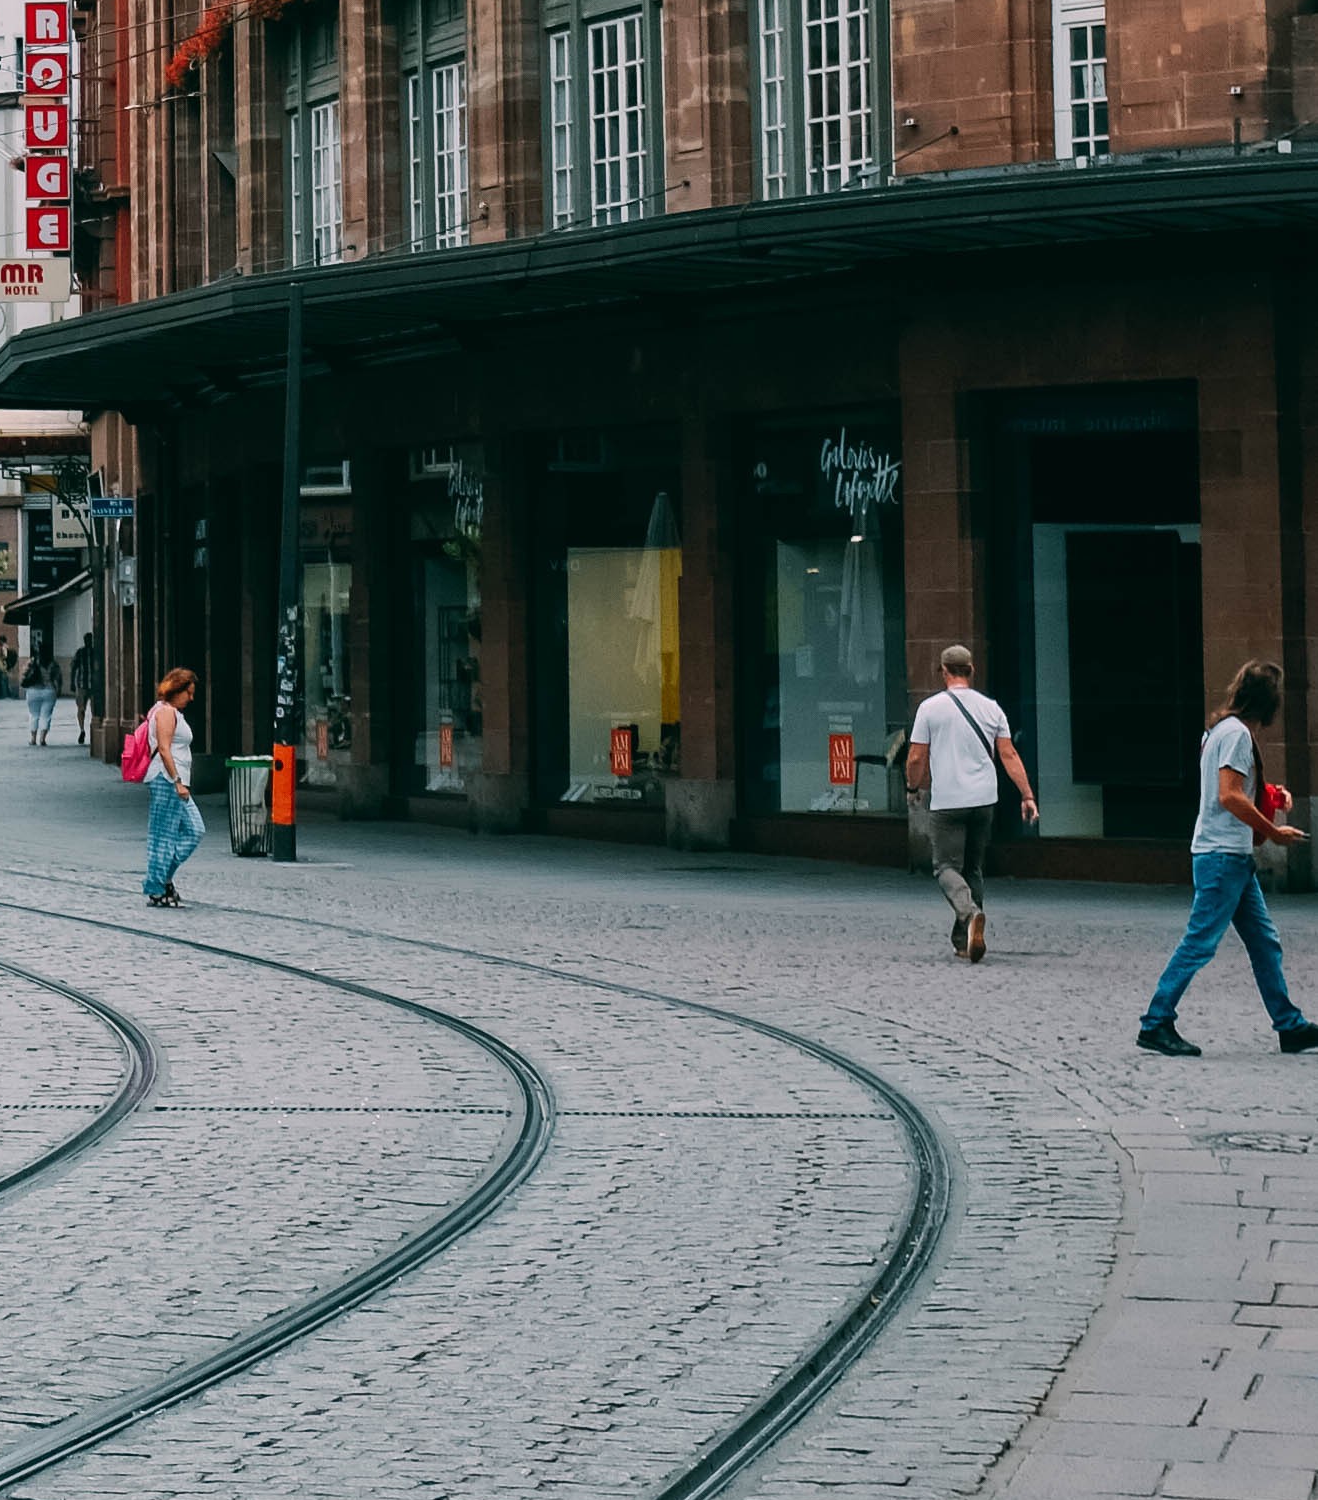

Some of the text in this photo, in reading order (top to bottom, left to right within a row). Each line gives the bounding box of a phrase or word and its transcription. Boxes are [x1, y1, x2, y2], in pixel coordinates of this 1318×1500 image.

[31, 9, 62, 245] ROUGE
[5, 286, 39, 296] HOTEL
[832, 740, 851, 758] AM
[833, 760, 851, 779] PM
